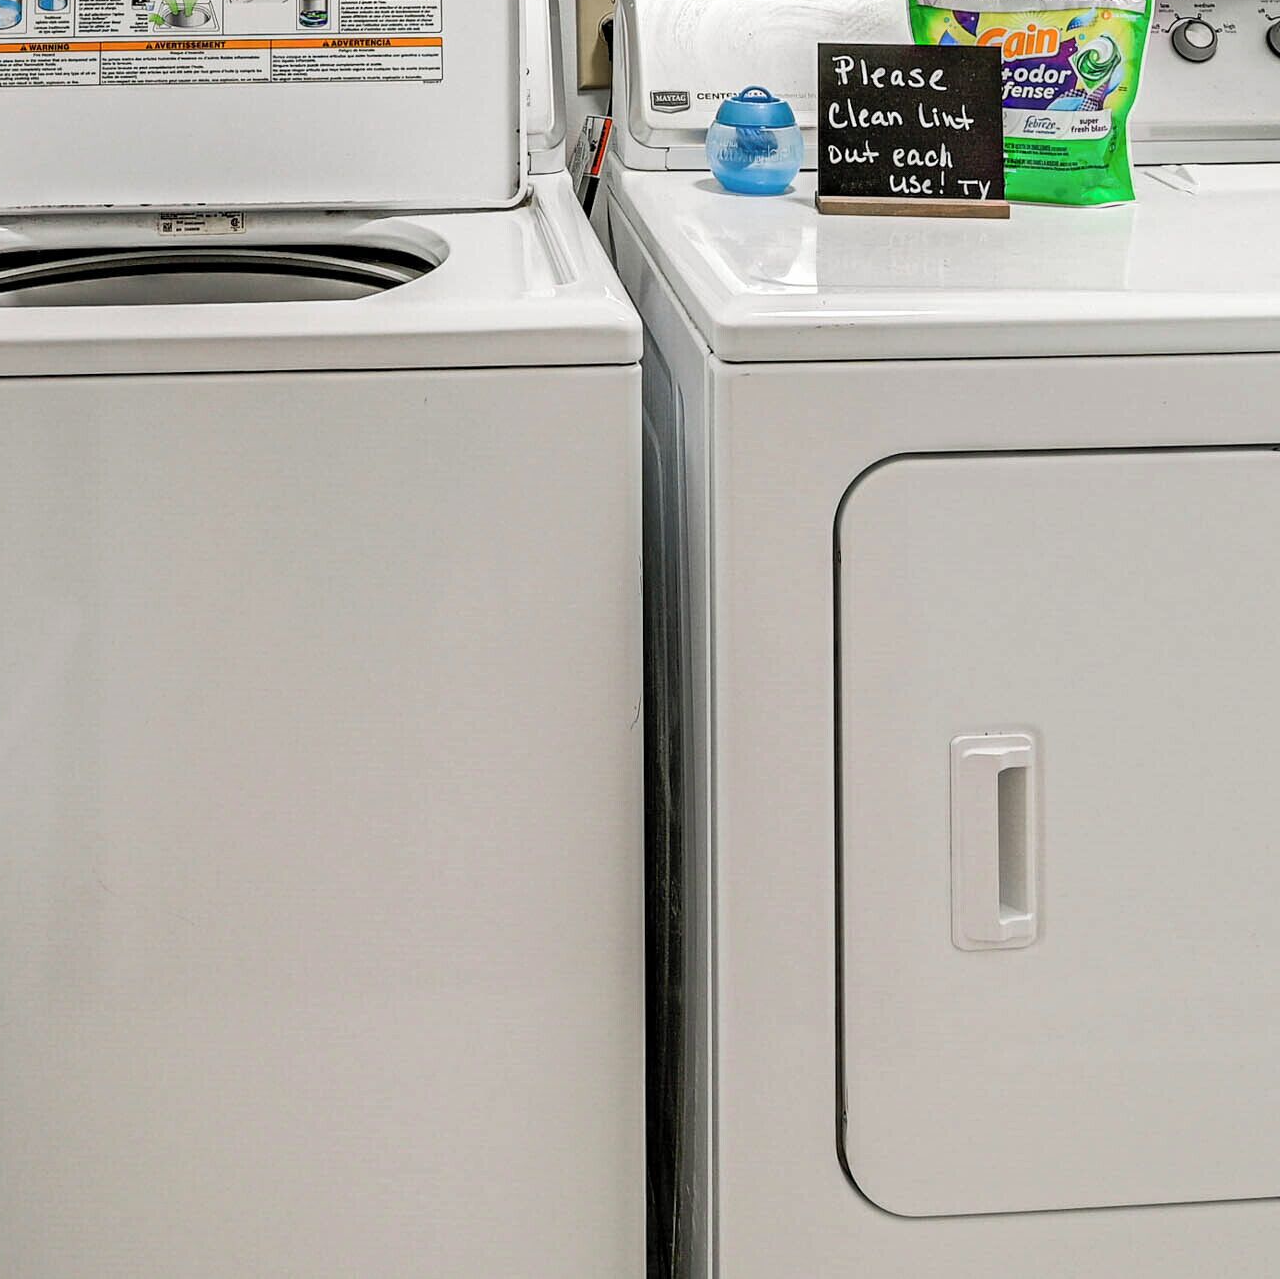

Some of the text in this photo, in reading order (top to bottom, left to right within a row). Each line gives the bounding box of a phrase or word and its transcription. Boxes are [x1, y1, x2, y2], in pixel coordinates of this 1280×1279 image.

[977, 24, 1059, 58] Gain
[832, 55, 947, 91] Please
[655, 94, 686, 102] MAYTAG
[1002, 82, 1055, 100] fense
[828, 98, 904, 128] Clean
[892, 143, 953, 168] each
[957, 180, 991, 200] TY
